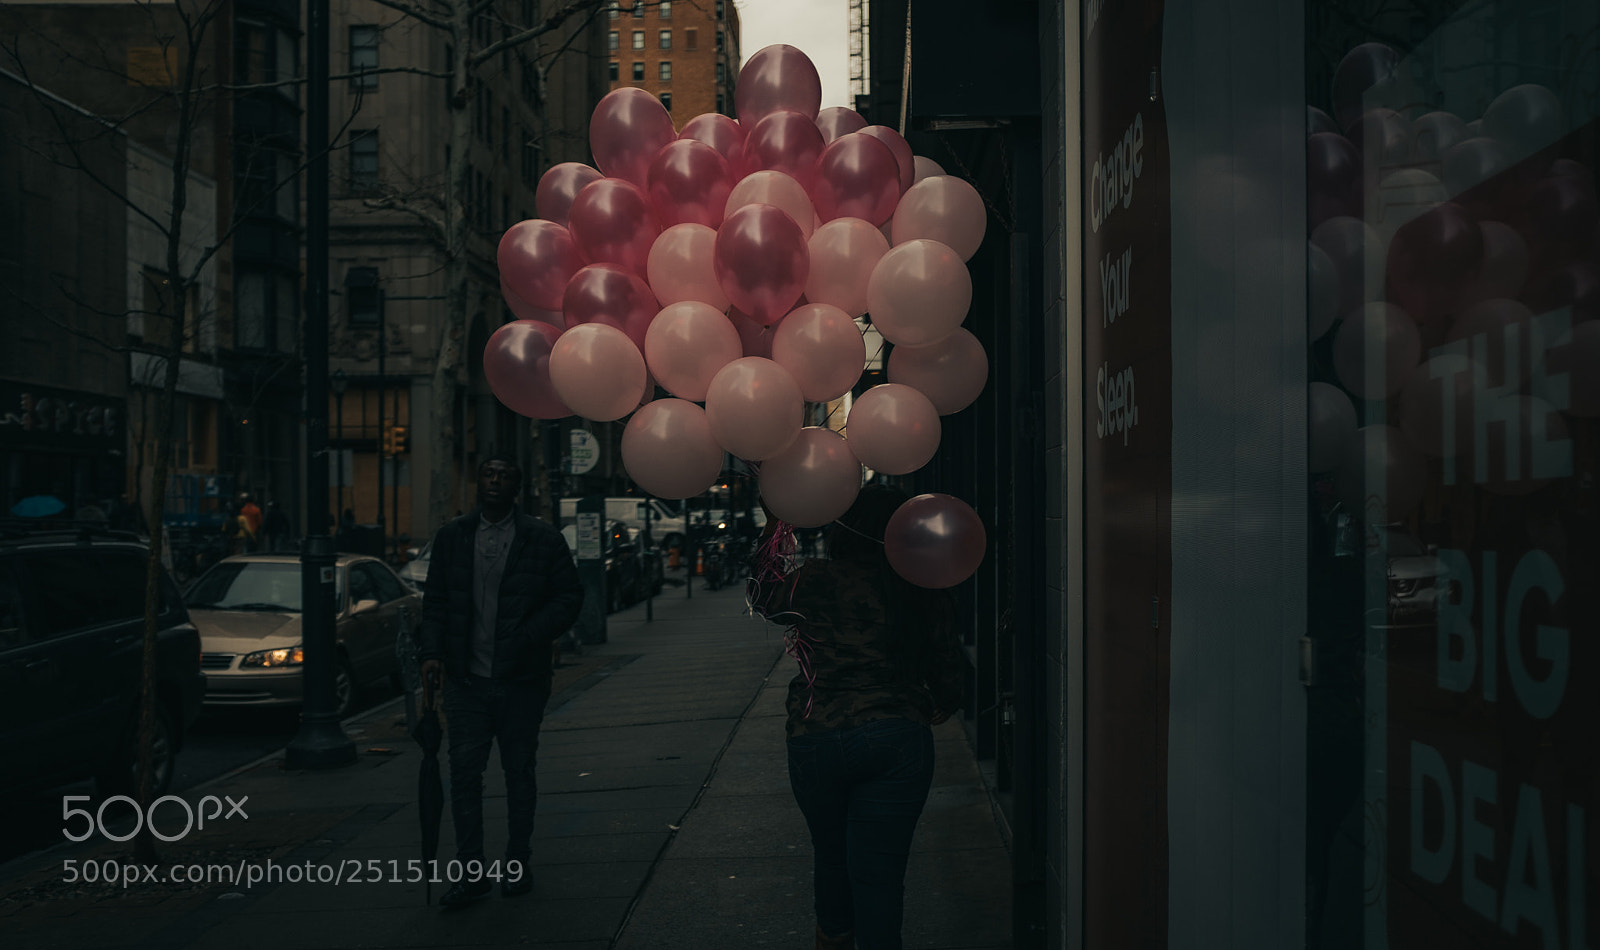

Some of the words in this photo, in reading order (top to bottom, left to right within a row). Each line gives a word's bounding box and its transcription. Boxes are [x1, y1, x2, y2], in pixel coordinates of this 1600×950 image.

[1091, 112, 1143, 232] Change
[1100, 245, 1132, 328] Your
[1097, 361, 1138, 446] Sleep.
[1429, 304, 1574, 486] THE
[1436, 549, 1570, 720] BIG
